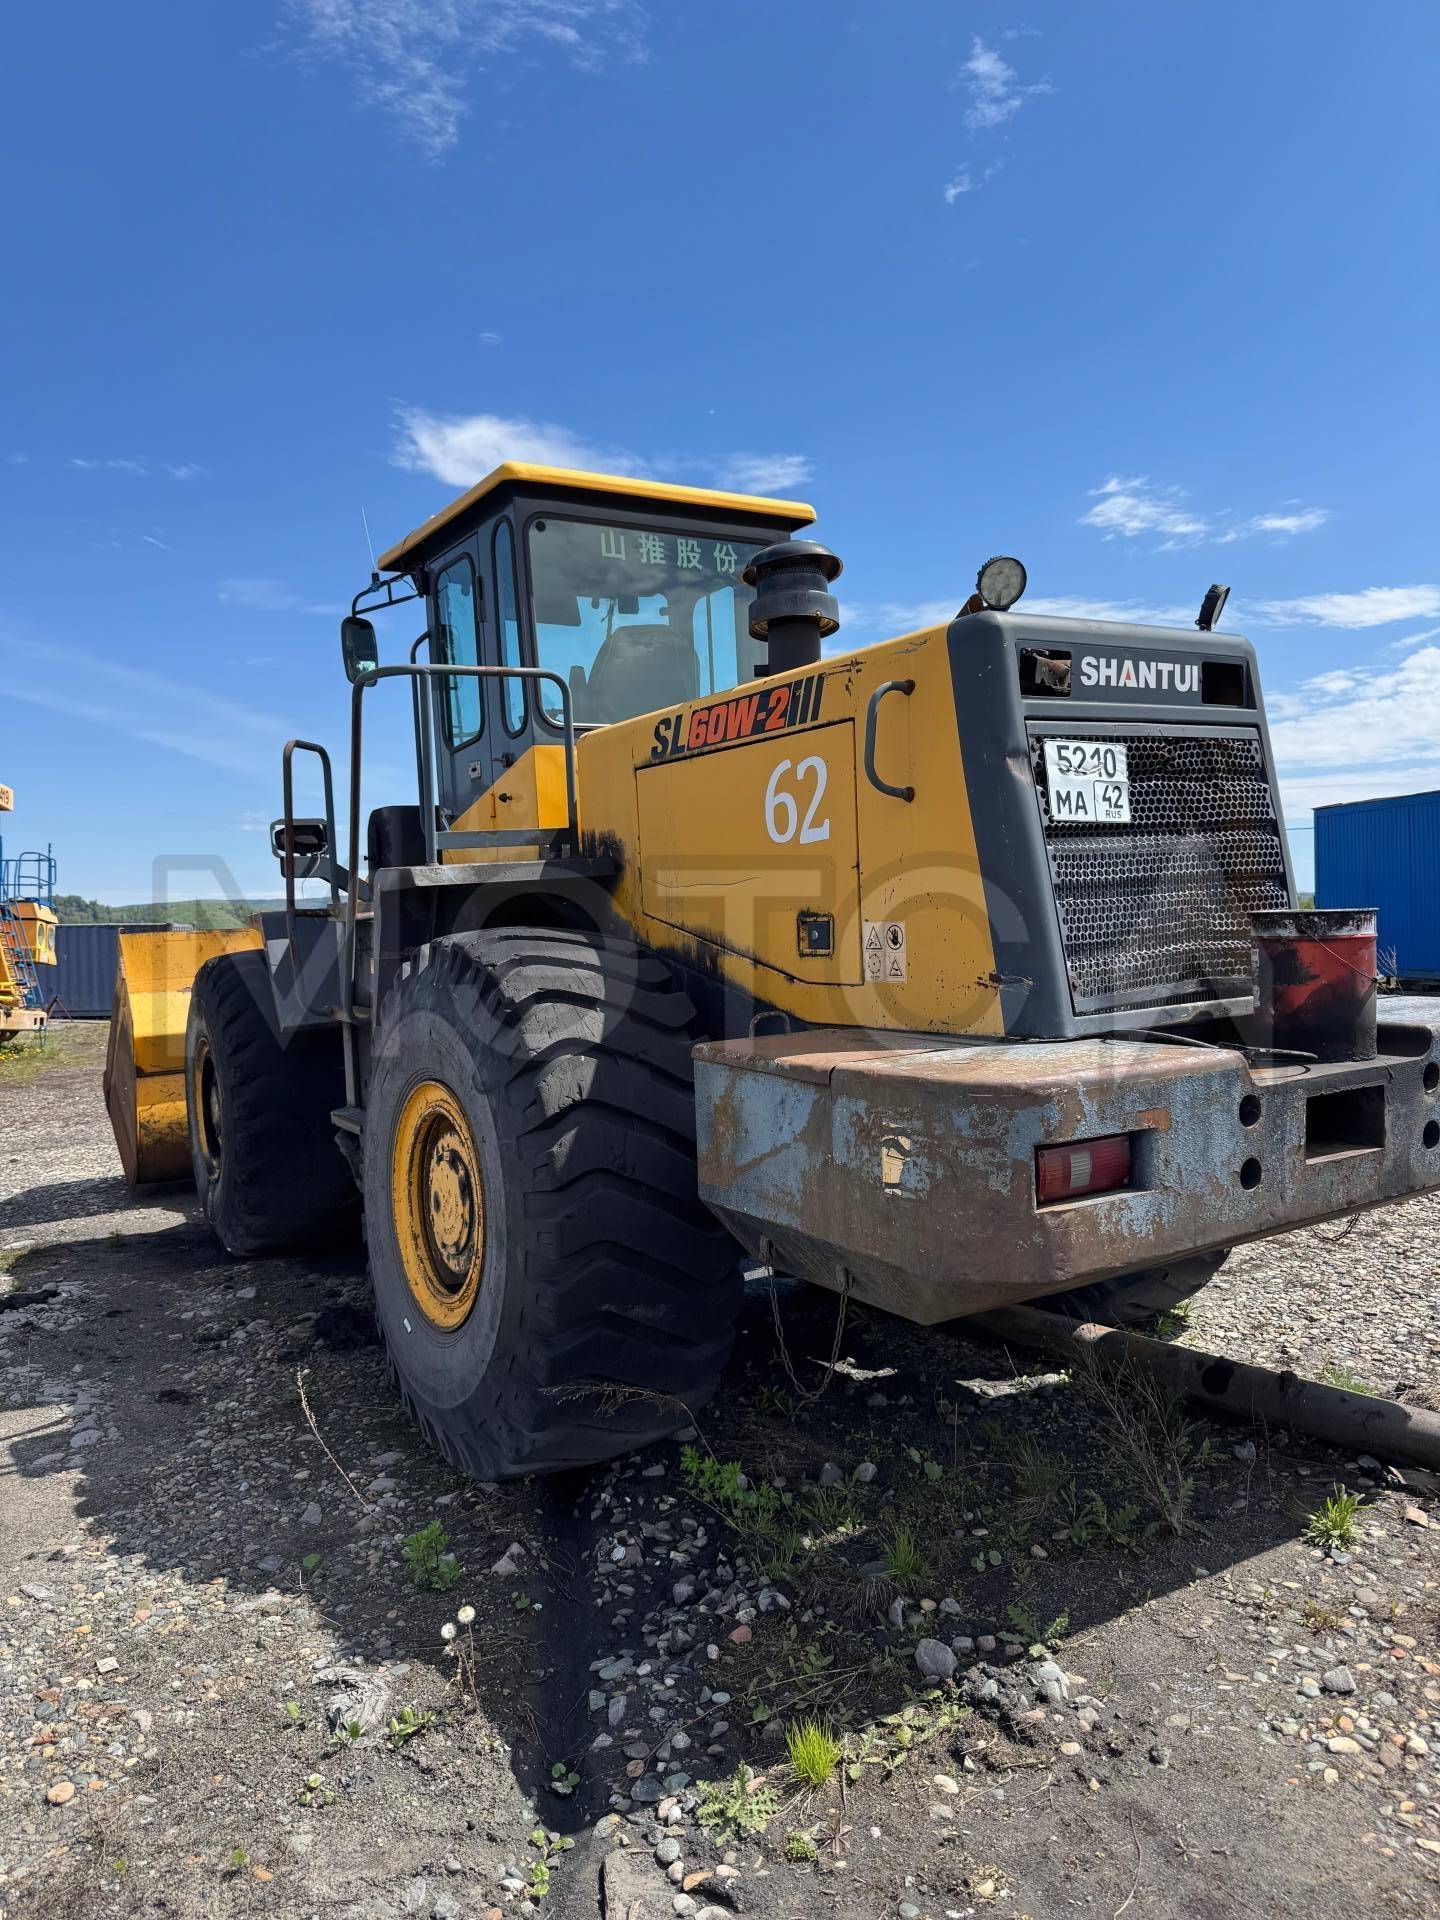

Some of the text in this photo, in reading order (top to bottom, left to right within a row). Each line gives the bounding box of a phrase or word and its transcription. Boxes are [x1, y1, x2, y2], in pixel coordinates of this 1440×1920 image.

[600, 529, 738, 574] 山推股份
[1080, 656, 1199, 692] SHANTUI
[1056, 744, 1117, 778] 5210
[764, 755, 830, 845] 62
[1102, 784, 1124, 809] 42
[1105, 809, 1122, 818] RUS
